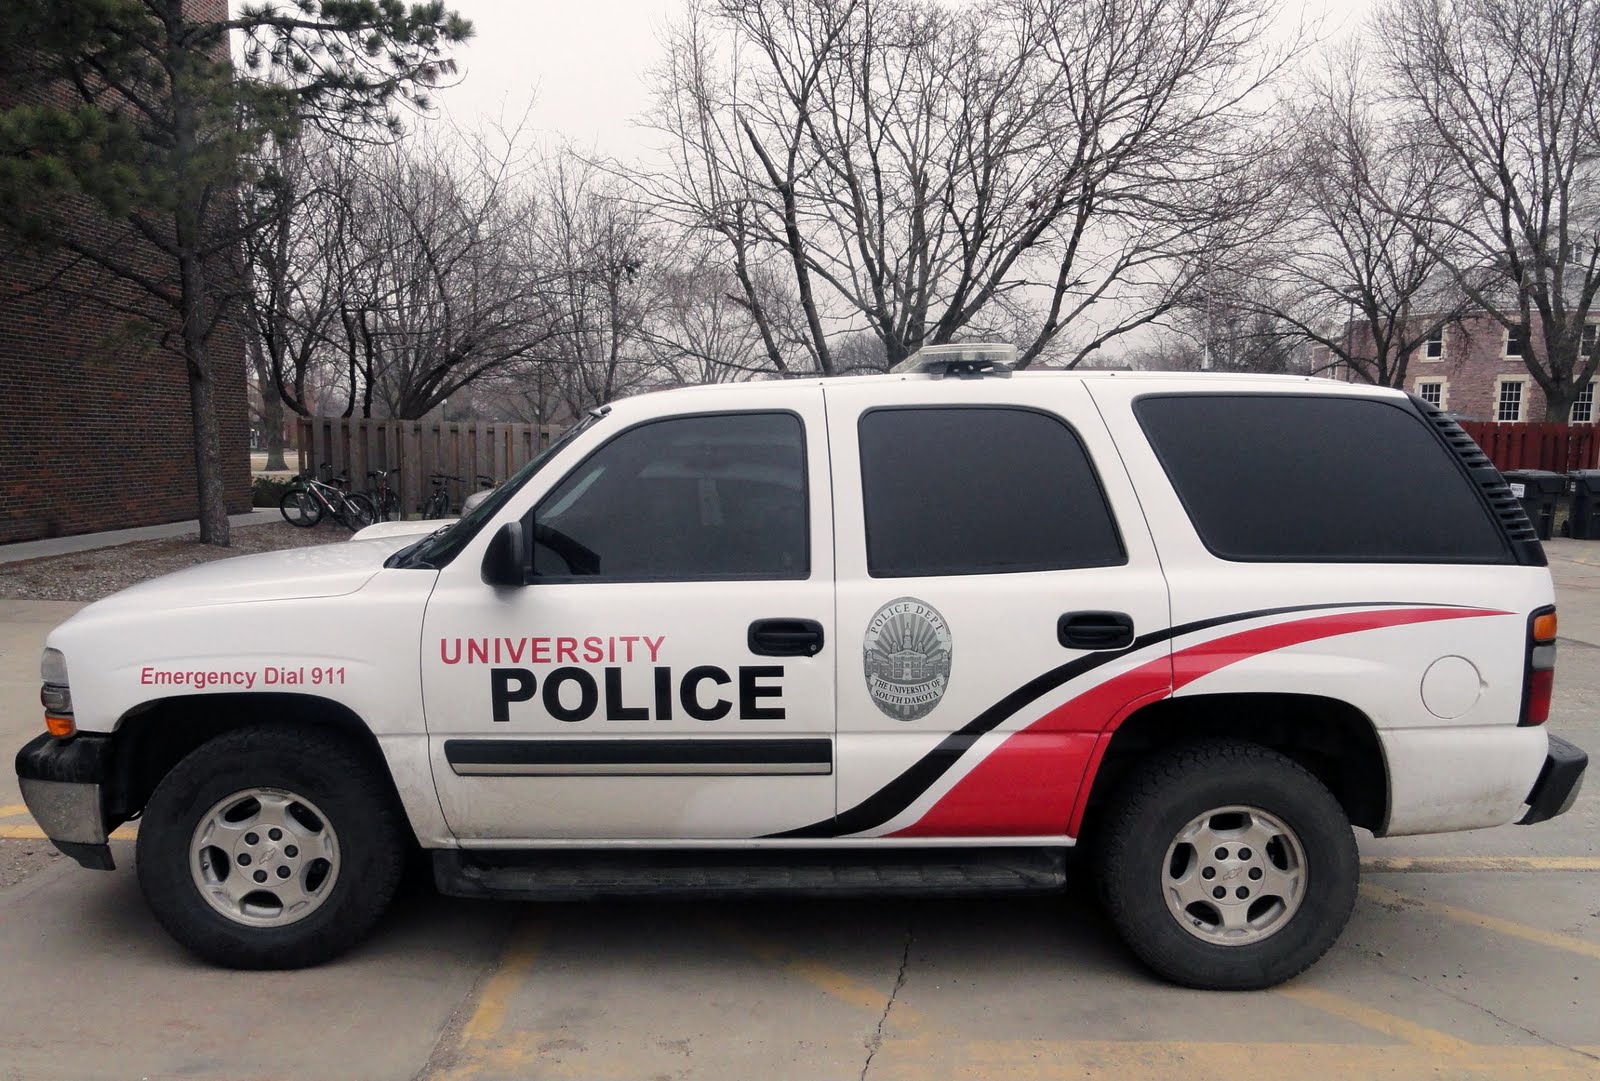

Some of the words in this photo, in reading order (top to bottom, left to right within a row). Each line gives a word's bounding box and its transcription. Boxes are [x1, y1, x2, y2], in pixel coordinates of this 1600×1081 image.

[870, 603, 910, 635] POLICE
[915, 605, 945, 635] DEPT.
[440, 636, 666, 664] UNIVERSITY
[140, 667, 257, 689] Emergency
[264, 667, 304, 685] Dial
[311, 666, 346, 685] 911
[874, 679, 887, 690] THE
[888, 682, 932, 695] UNIVERSITY
[932, 679, 941, 688] OF
[490, 665, 786, 722] POLICE
[874, 690, 902, 704] SOUTH
[904, 690, 939, 704] DAKOTA
